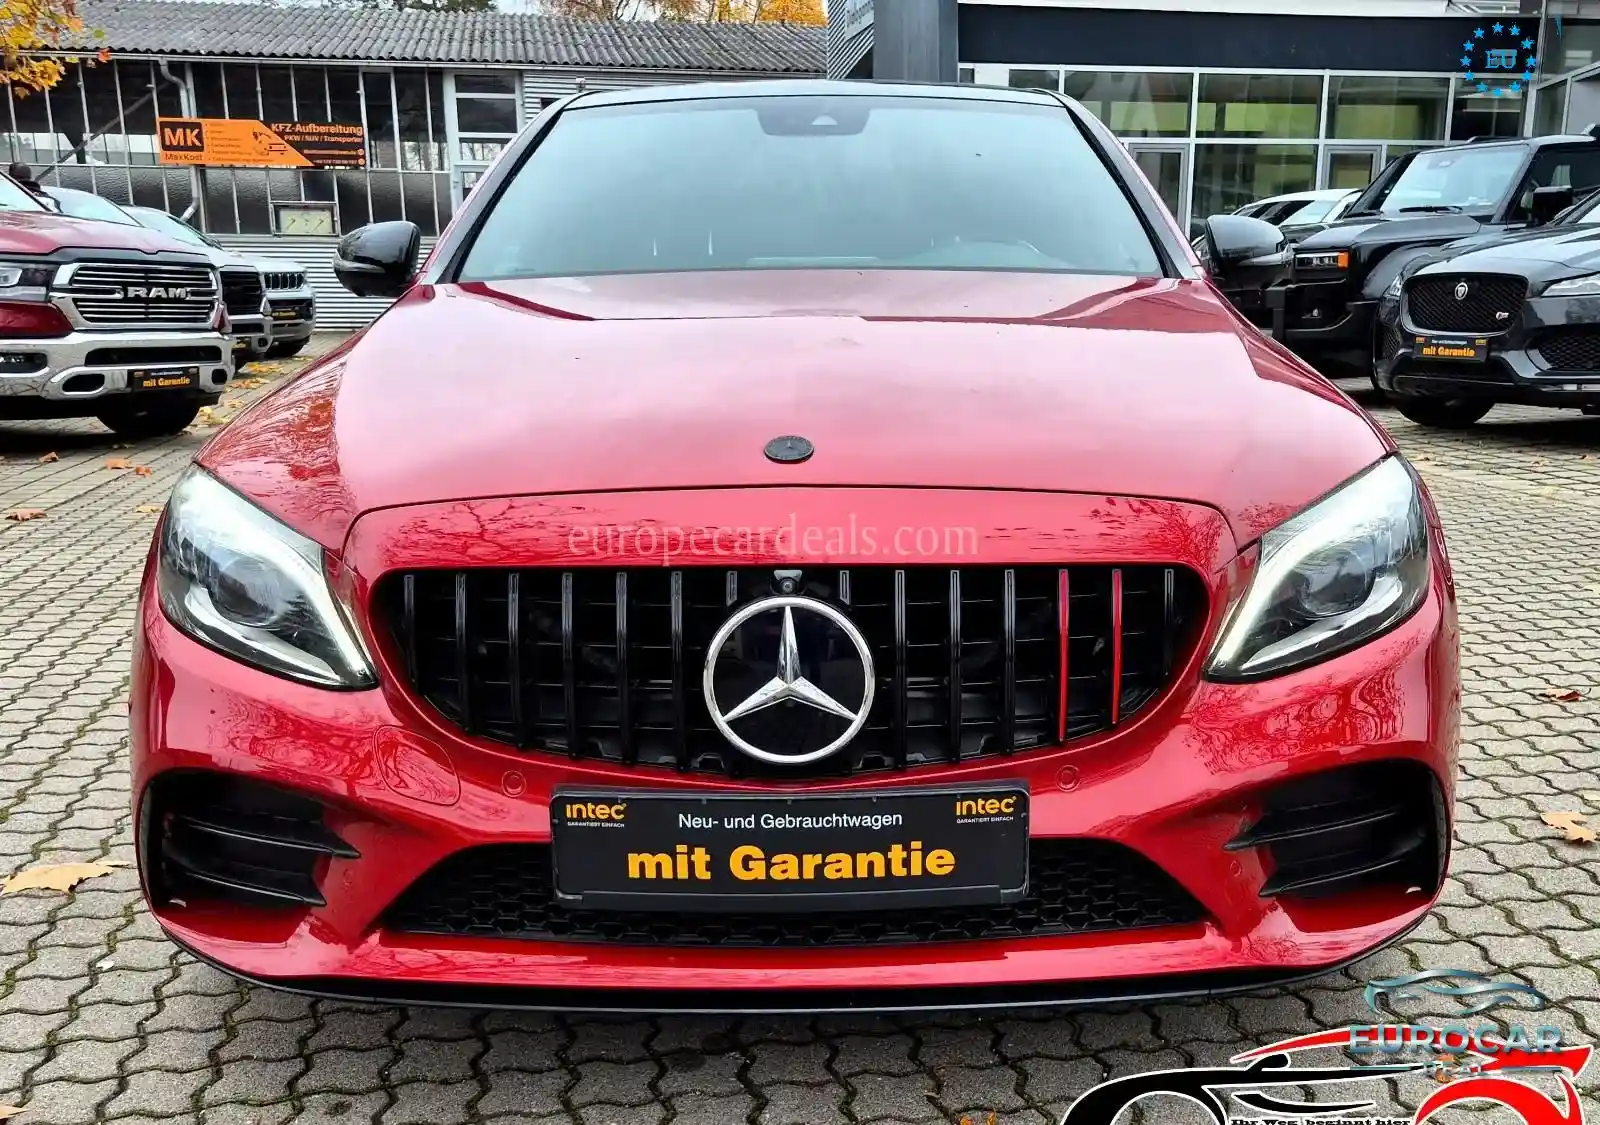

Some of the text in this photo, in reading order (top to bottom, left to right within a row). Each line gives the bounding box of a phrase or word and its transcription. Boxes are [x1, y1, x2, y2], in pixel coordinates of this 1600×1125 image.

[164, 127, 202, 147] MK
[271, 123, 363, 135] KFZ-Aufbereitung
[127, 286, 187, 300] RAM
[1422, 346, 1475, 357] mit Garantie
[142, 376, 191, 387] mit Garantie
[565, 802, 626, 820] intec
[955, 798, 1014, 816] intec
[678, 811, 904, 832] Neu- und Gebrauchtwagen
[627, 840, 956, 881] mit Garantie
